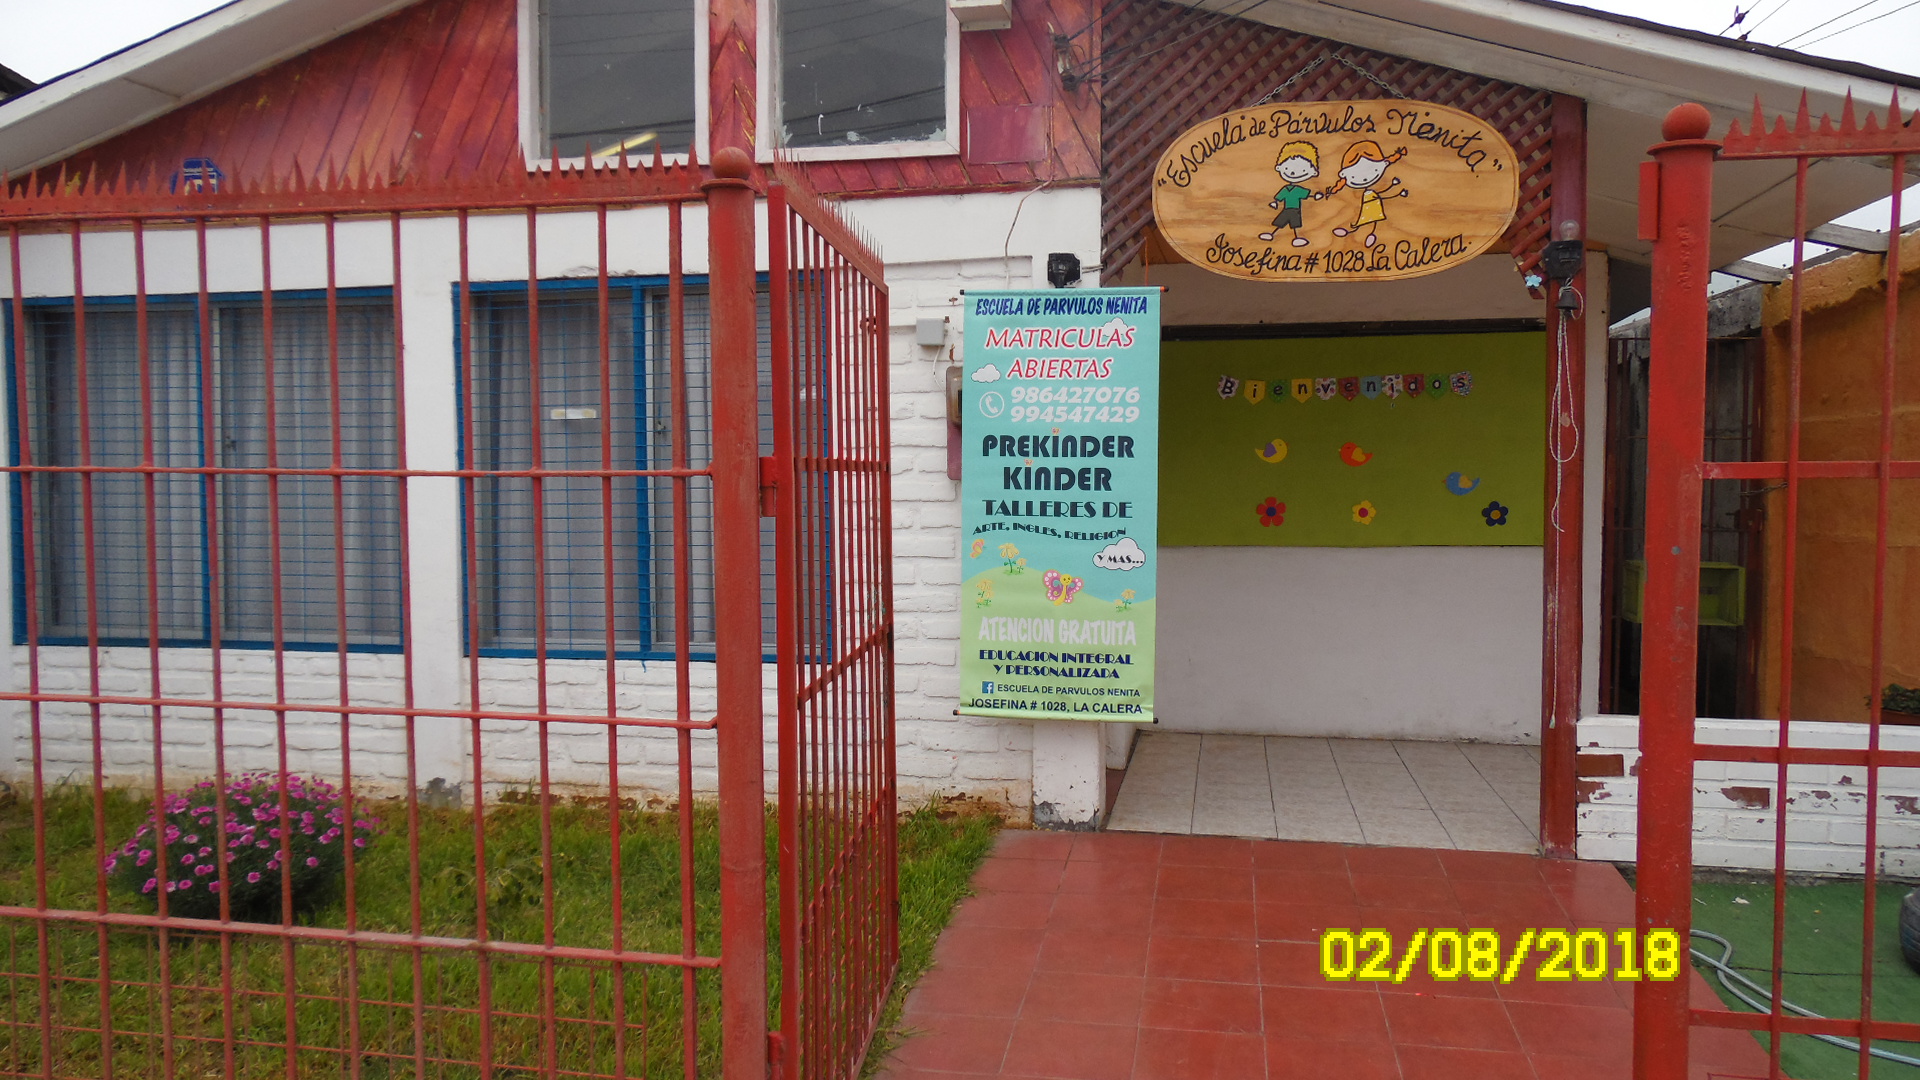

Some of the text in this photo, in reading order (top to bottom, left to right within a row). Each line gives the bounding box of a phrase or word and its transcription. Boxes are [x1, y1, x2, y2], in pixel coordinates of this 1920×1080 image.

[1249, 117, 1267, 136] de
[1206, 233, 1302, 275] Josefina
[1304, 254, 1319, 272] #
[1324, 250, 1365, 273] 1028
[1366, 244, 1391, 272] La
[975, 297, 1148, 315] ESCUELA DE PARVULOS NENITA
[984, 327, 1136, 348] MATRICULAS
[1006, 357, 1114, 379] ABIERTAS
[1011, 386, 1141, 404] 986427076
[1011, 406, 1140, 423] 994547429
[982, 500, 1133, 518] TALLERES DE
[972, 522, 1127, 541] ARTE, INGLES, RELIGION
[1097, 554, 1105, 563] Y
[978, 616, 1136, 646] ATENCION GRATUITA
[979, 649, 1134, 665] EDUCACION INTEGRAL
[993, 664, 1120, 679] Y PERSONALIZADA
[997, 684, 1039, 694] ESCUELA
[1041, 685, 1053, 694] DE
[1055, 686, 1105, 696] PARVULOS
[1107, 688, 1141, 697] NENITA
[968, 698, 1143, 714] JOSEFINA # 1028, LA CALERA
